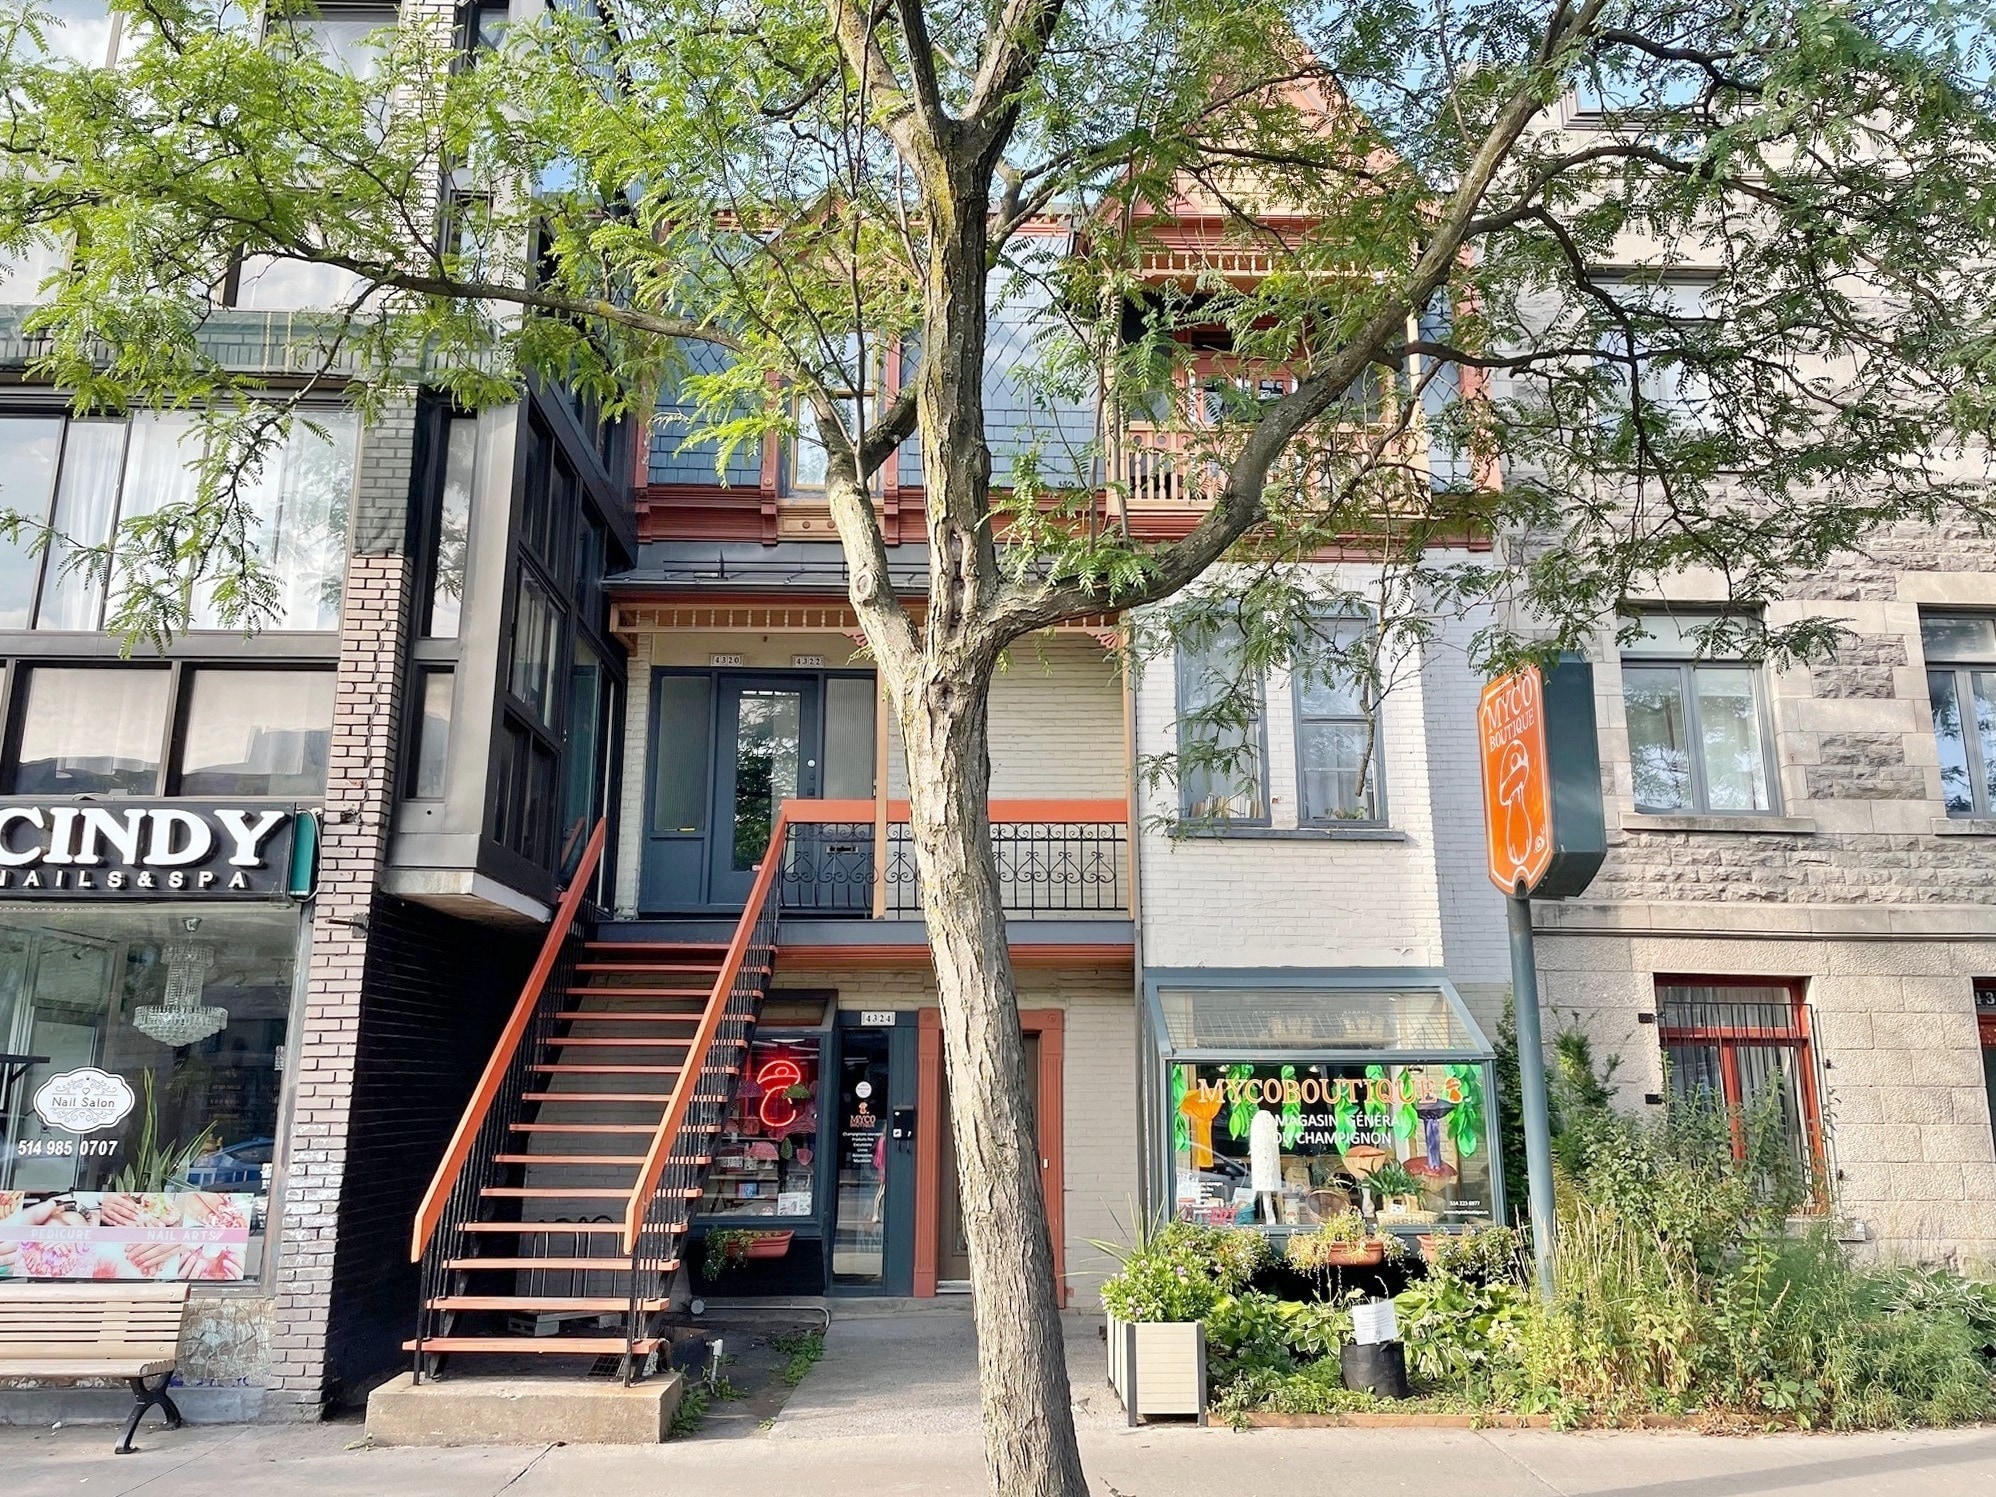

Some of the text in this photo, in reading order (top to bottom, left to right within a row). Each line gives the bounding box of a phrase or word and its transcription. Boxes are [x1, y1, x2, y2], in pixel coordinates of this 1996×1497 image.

[714, 656, 740, 665] 4320
[796, 657, 822, 666] 4322
[1486, 675, 1534, 733] MYCO
[1489, 707, 1535, 753] BOUTIQUE
[0, 806, 285, 866] CINDY
[865, 1013, 892, 1024] 4324
[1198, 1078, 1438, 1105] MYCOBOUTIQUE
[51, 1096, 115, 1108] Nail Salon
[850, 1115, 876, 1124] MYCO
[1274, 1114, 1338, 1127] MAGASIN
[1296, 1131, 1392, 1145] CHAMPIGNON
[17, 1139, 118, 1156] 514 985 0707
[30, 1229, 92, 1241] PEDICURE
[146, 1229, 217, 1242] NAIL ARTS
